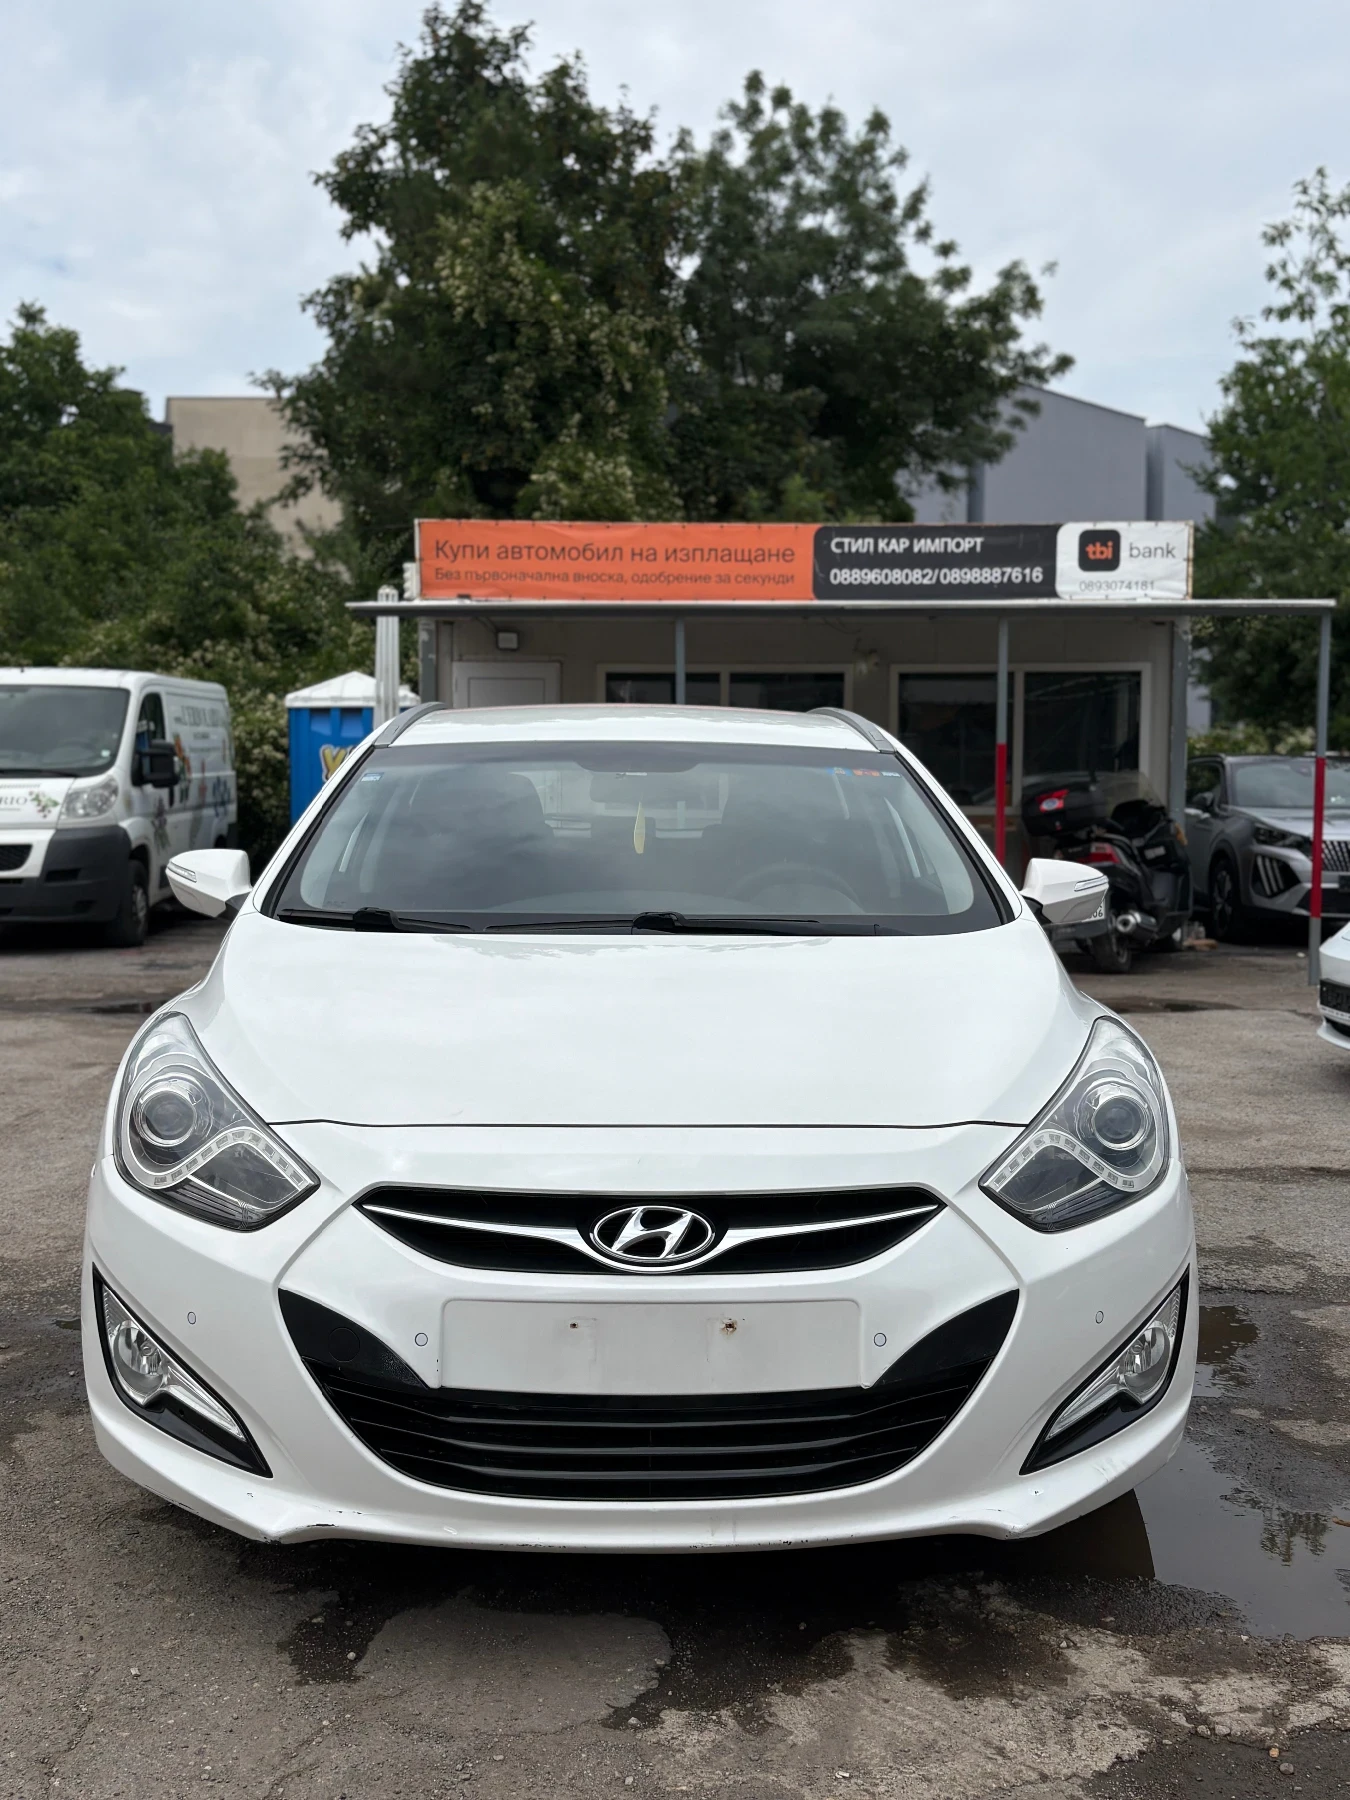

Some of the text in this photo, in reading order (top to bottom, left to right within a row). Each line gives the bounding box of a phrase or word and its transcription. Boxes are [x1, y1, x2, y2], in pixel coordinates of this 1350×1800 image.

[434, 539, 796, 566] Купи автомобил на изплащане
[830, 537, 985, 553] СТИЛ КАР ИМПОРТ
[1085, 541, 1176, 560] tbi bank
[434, 567, 795, 586] Без първоначална вноска, одобрение за секунди
[829, 566, 1043, 585] 0889608082/0898887616
[1080, 580, 1155, 592] 0893074181
